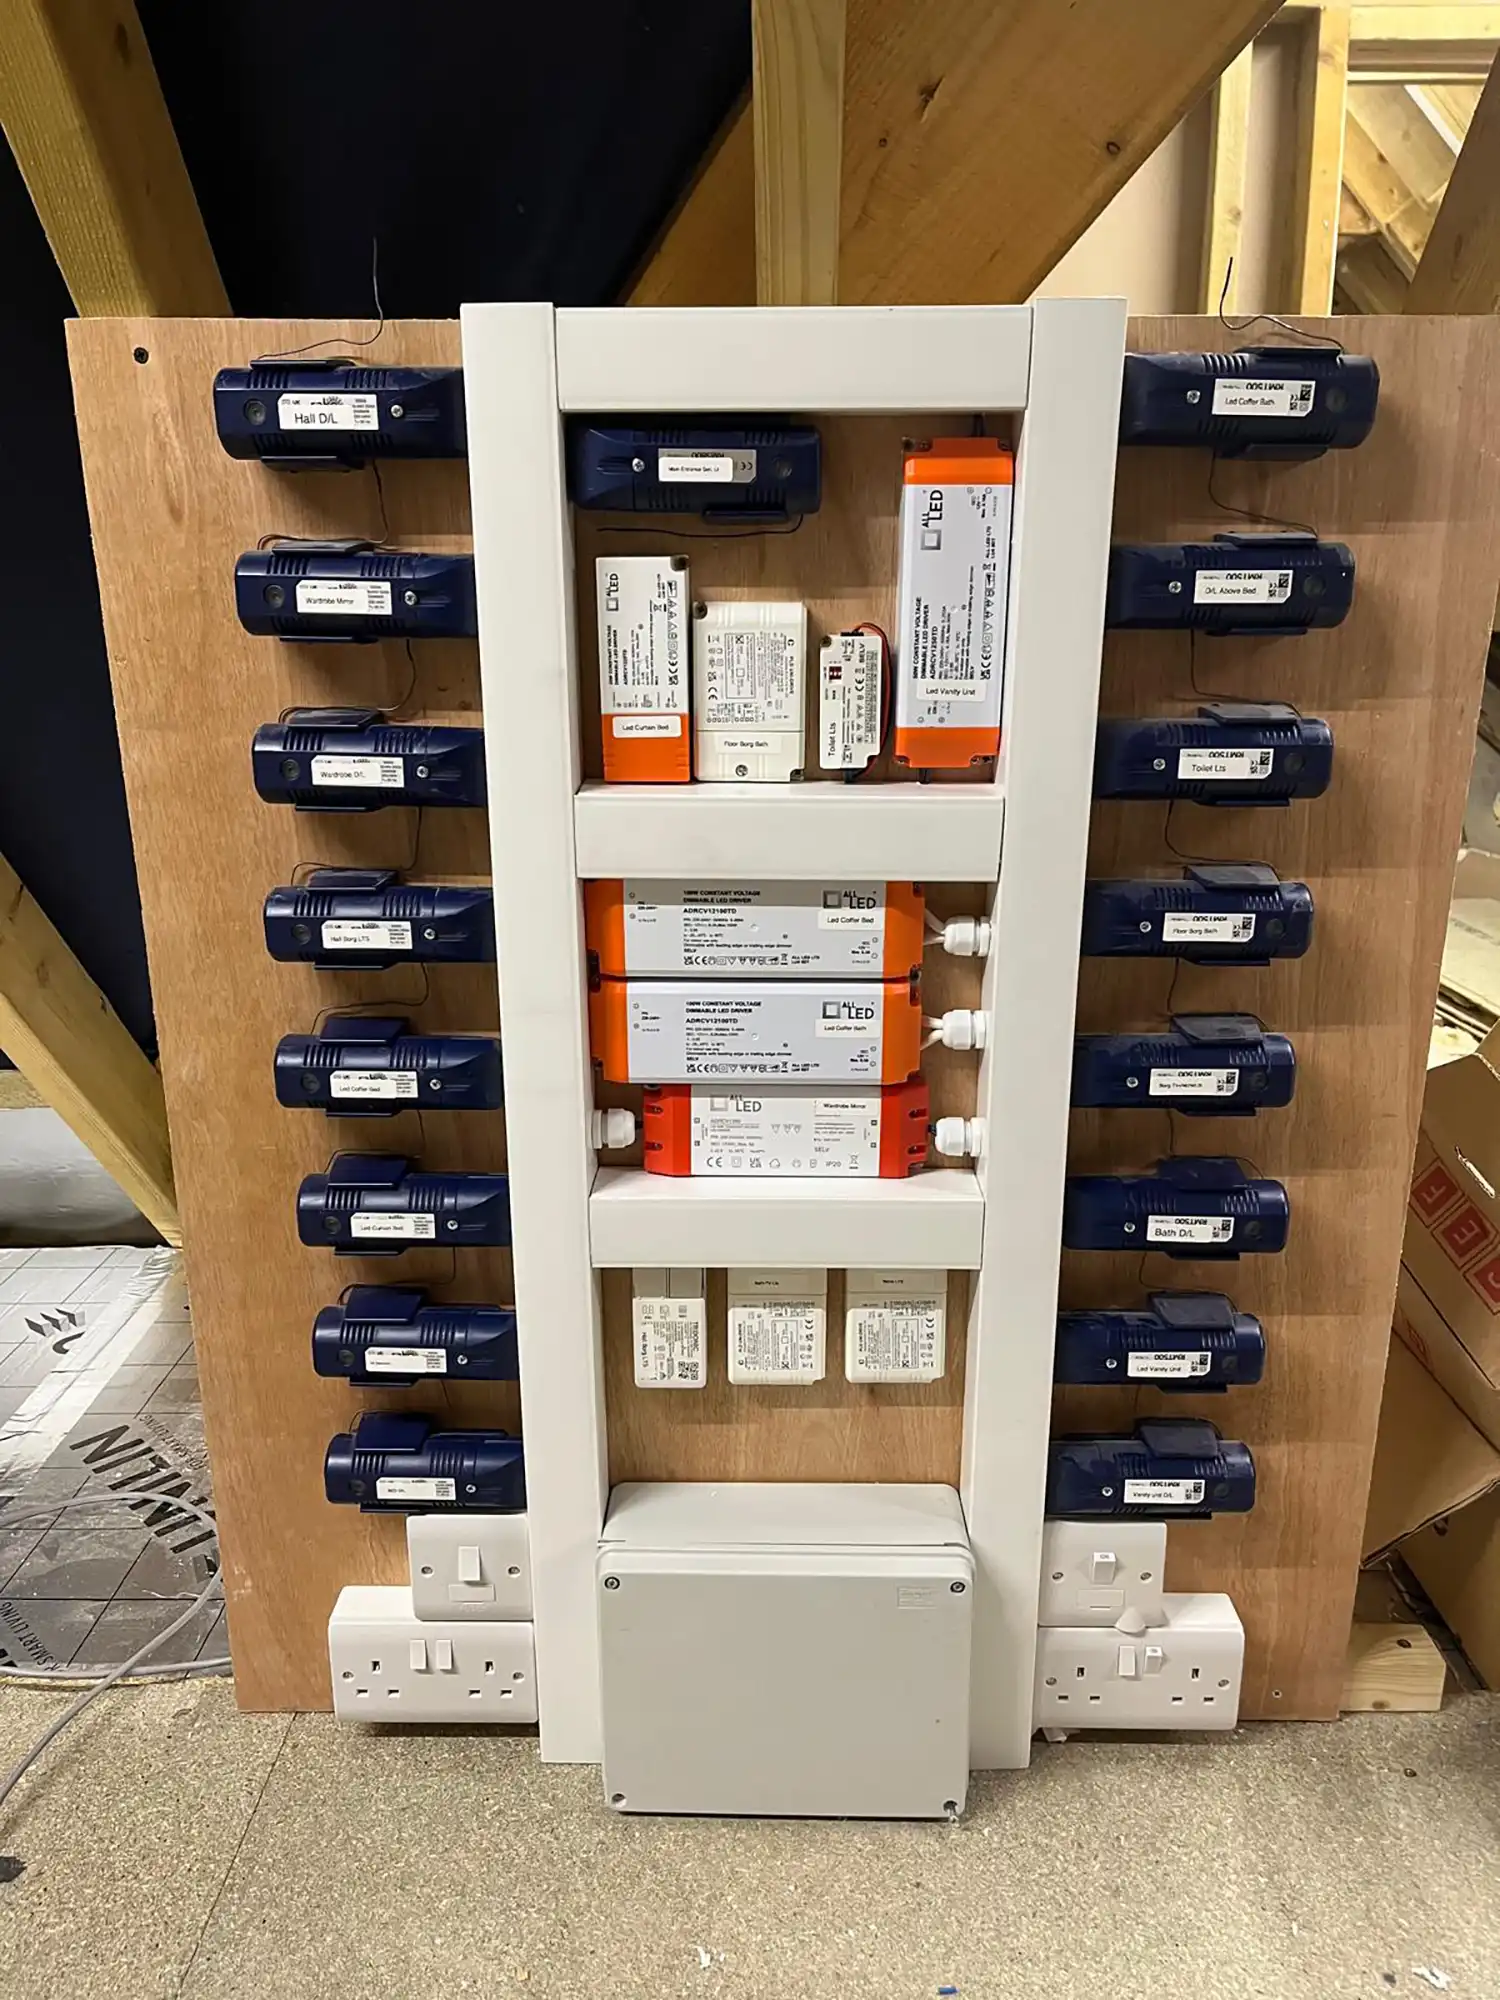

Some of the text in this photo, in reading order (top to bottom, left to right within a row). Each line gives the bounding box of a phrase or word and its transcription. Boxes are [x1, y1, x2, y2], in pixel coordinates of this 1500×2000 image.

[295, 413, 338, 424] Hall D/L
[929, 489, 944, 521] LED
[921, 512, 930, 528] ALL
[610, 573, 619, 593] LED
[940, 688, 961, 696] Vanity
[962, 688, 976, 696] Unit
[828, 735, 836, 756] Toilet
[1192, 765, 1212, 773] Toilet
[843, 890, 857, 898] ALL
[849, 897, 876, 909] LED
[848, 1007, 874, 1019] LED
[736, 1101, 762, 1112] LED
[706, 1157, 722, 1168] CE
[1175, 1218, 1207, 1226] RMT500
[1155, 1228, 1195, 1238] Bath D/L
[18, 1633, 54, 1665] SMART
